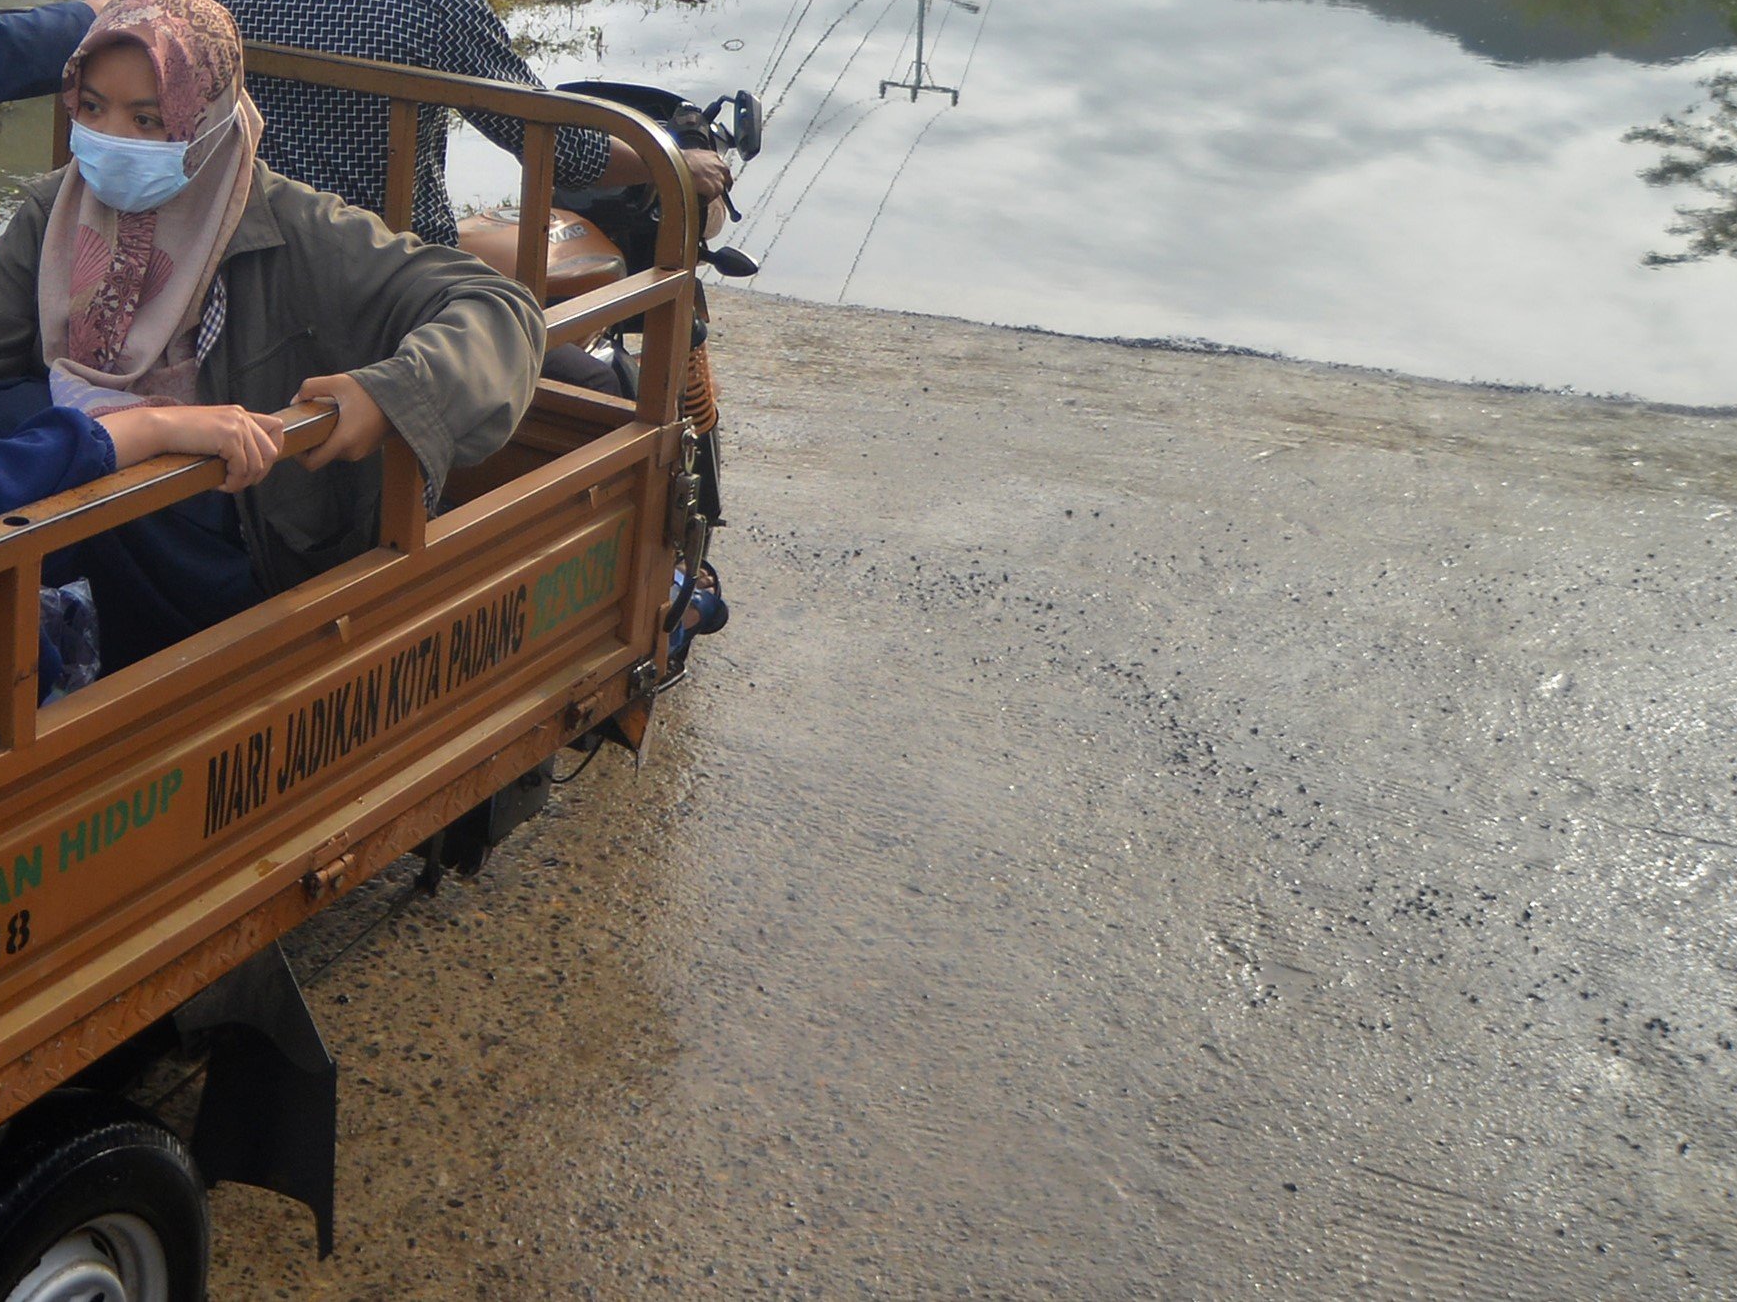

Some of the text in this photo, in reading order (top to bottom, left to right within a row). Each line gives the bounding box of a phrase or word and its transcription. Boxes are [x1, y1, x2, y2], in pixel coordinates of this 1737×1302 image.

[204, 726, 272, 839] MARI
[276, 664, 383, 795] JADIKAN
[384, 631, 443, 731] KOTA
[446, 583, 528, 694] PADANG
[58, 768, 185, 875] HIDUP
